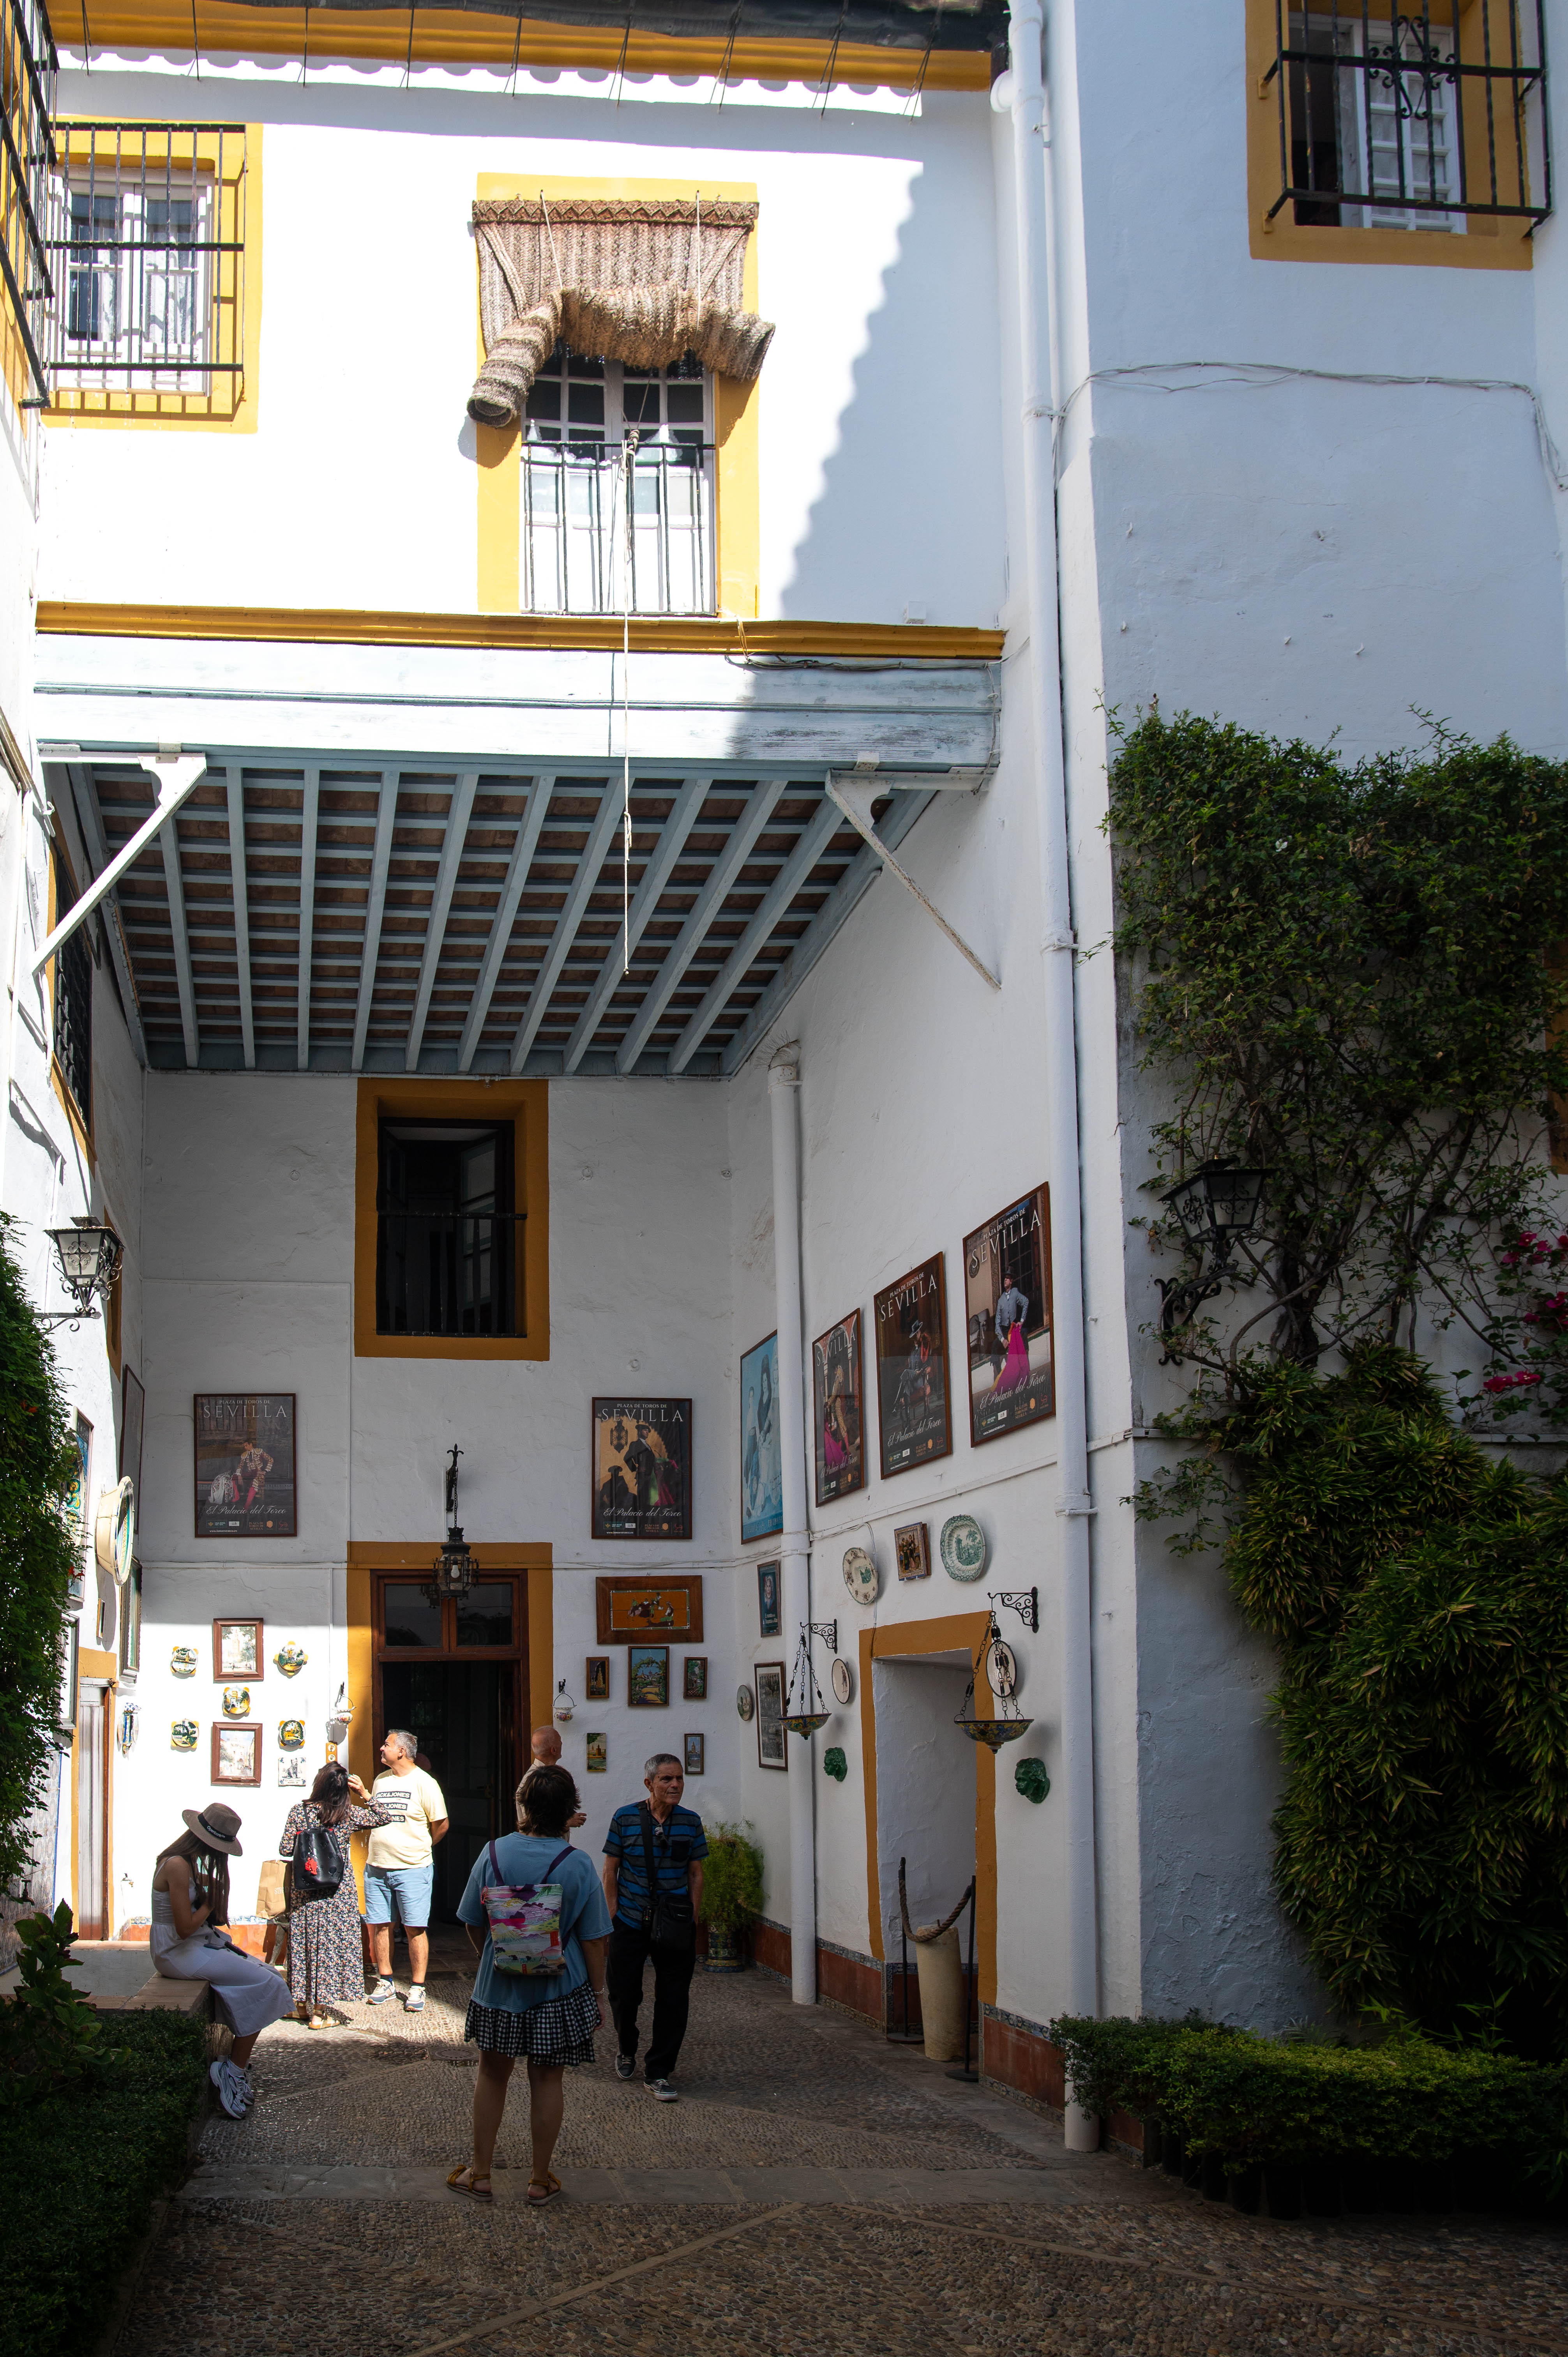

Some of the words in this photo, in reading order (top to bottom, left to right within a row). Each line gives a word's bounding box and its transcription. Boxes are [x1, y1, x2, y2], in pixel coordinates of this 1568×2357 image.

[983, 1228, 996, 1240] PLAZA
[997, 1223, 1003, 1231] DE
[1004, 1212, 1018, 1226] TOROS
[1019, 1207, 1026, 1216] DE
[972, 1209, 1041, 1268] SEVILLA
[881, 1274, 937, 1322] SEVILLA
[890, 1288, 901, 1298] PLAZA
[906, 1276, 919, 1287] TOROS
[817, 1328, 855, 1366] SEVILLA
[980, 1393, 989, 1409] El
[988, 1386, 1013, 1406] Palacio
[1015, 1375, 1027, 1394] del
[204, 1405, 287, 1418] SEVILLA
[602, 1408, 684, 1422] SEVILLA
[888, 1432, 895, 1447] El
[895, 1427, 915, 1444] Palacio
[916, 1419, 926, 1435] del
[206, 1505, 218, 1515] El
[218, 1505, 247, 1515] Palacio
[250, 1505, 264, 1514] del
[603, 1507, 615, 1516] El
[614, 1507, 643, 1516] Palacio
[646, 1507, 660, 1516] del
